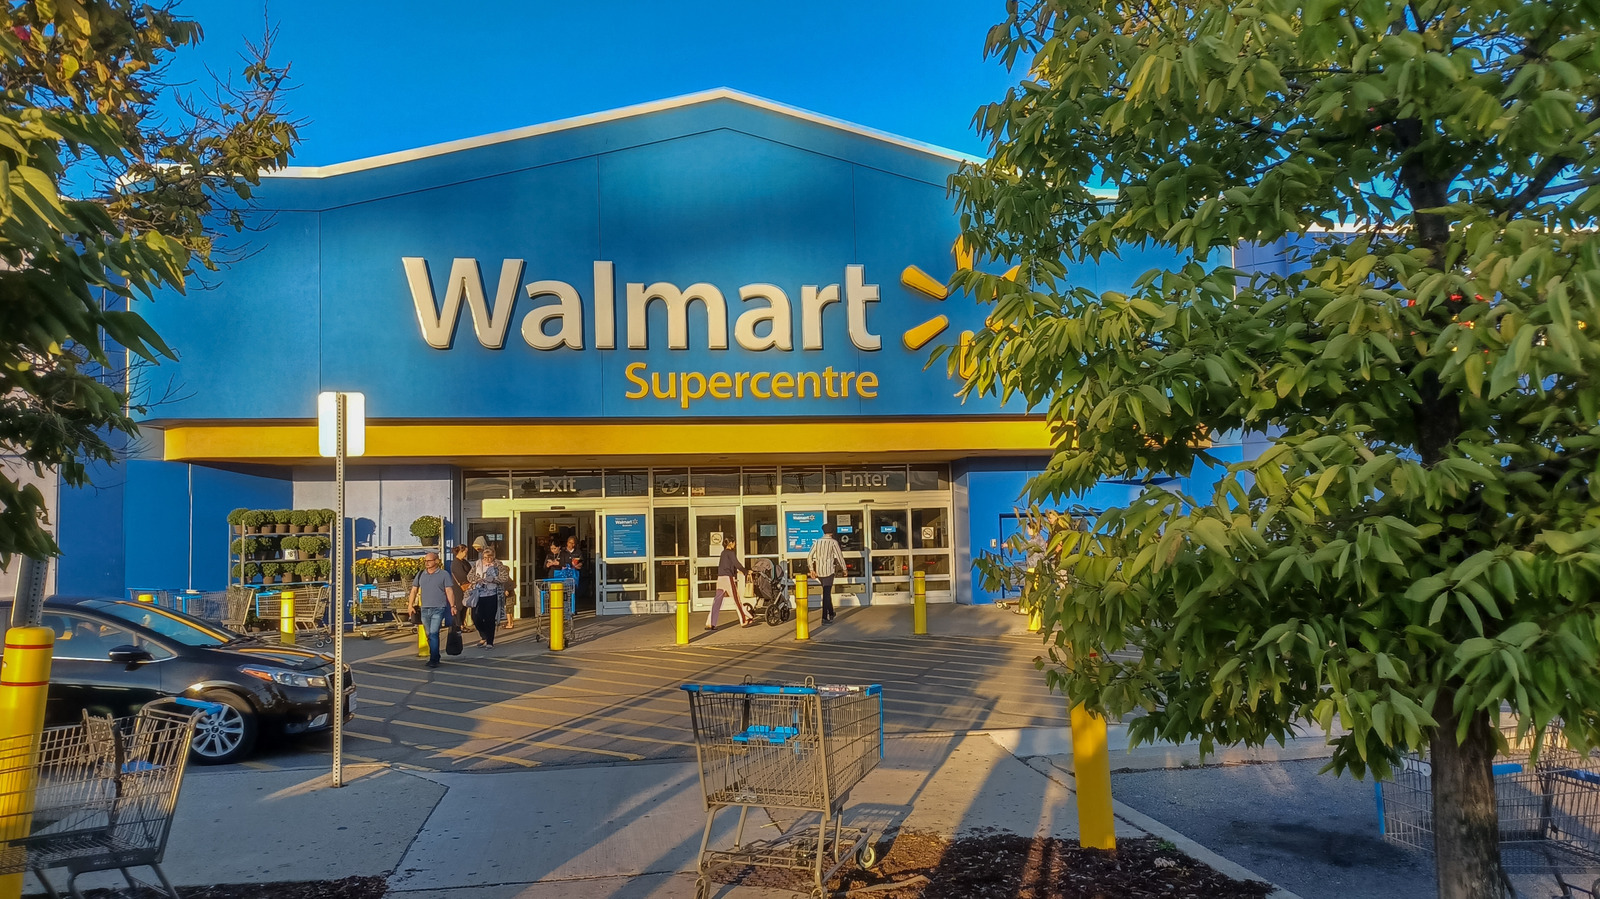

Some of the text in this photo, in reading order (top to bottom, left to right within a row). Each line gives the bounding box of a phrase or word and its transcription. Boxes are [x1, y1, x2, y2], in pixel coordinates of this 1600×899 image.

[401, 257, 882, 350] Walmart
[625, 362, 879, 409] Supercentre
[539, 475, 576, 491] Exit
[842, 471, 889, 486] Enter
